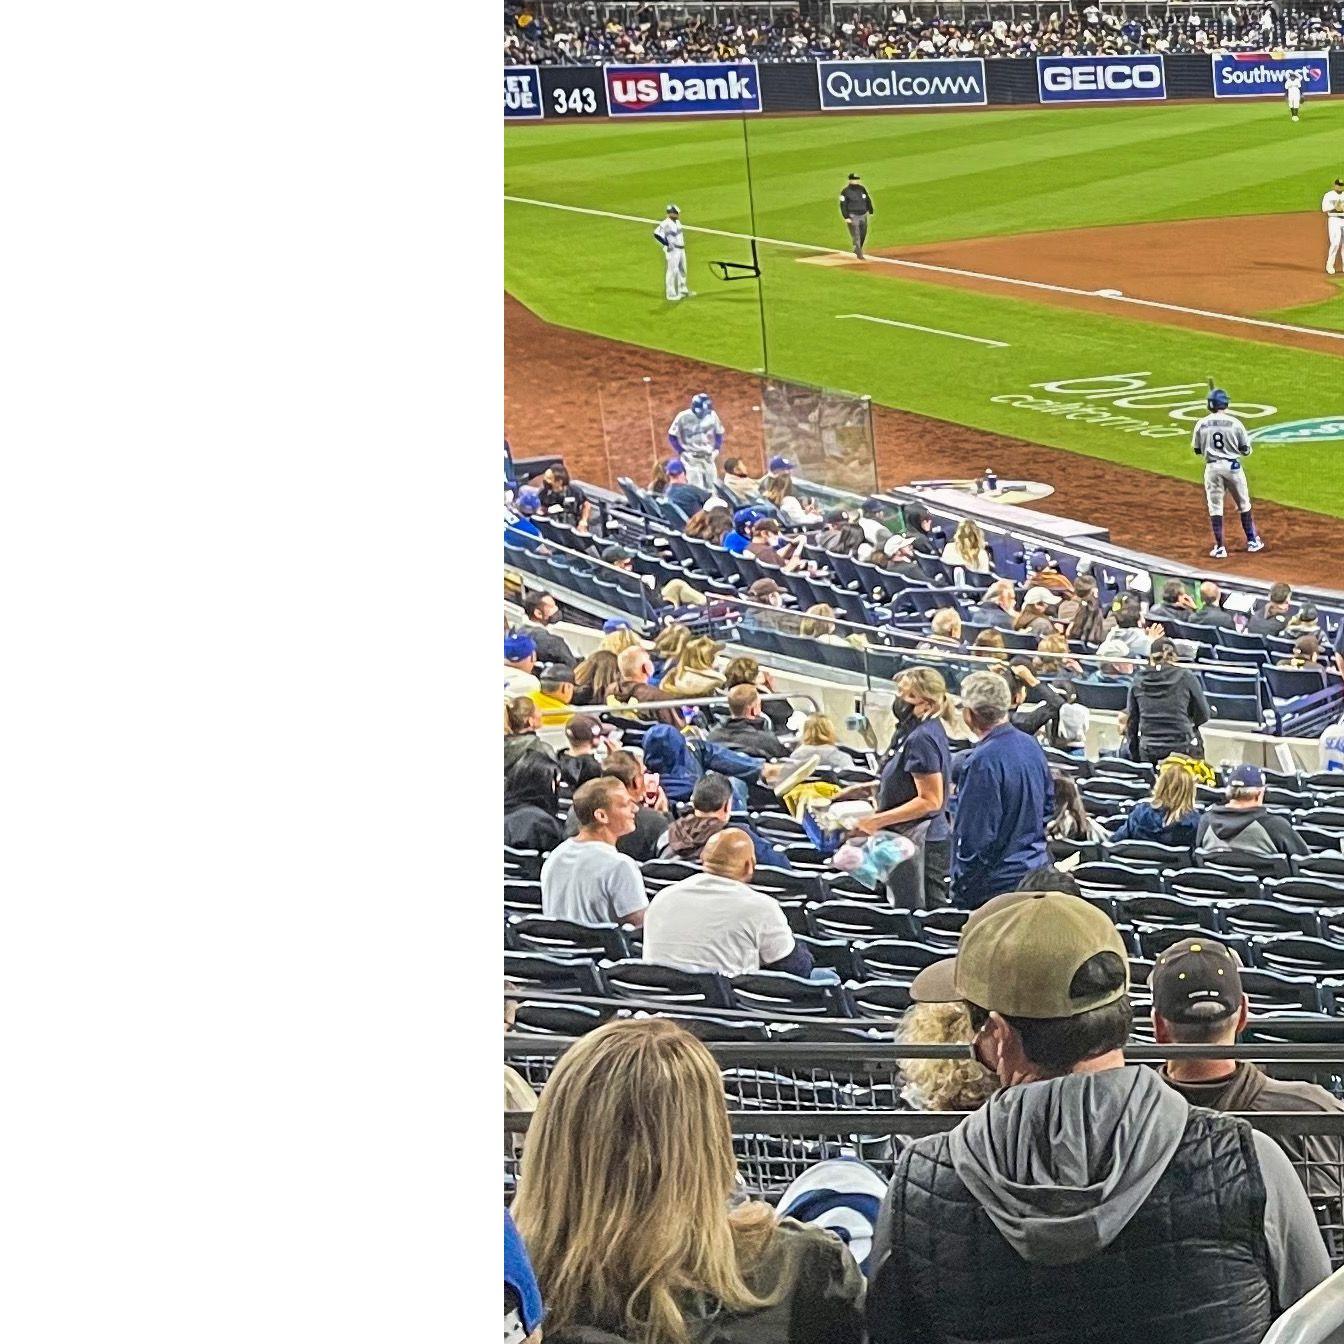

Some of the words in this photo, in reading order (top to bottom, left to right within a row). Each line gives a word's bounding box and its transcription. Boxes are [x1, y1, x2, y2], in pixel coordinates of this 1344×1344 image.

[504, 76, 530, 92] ET
[1044, 65, 1162, 91] GEICO
[1222, 64, 1310, 84] Southwest
[826, 70, 980, 101] Qualcomm
[504, 90, 536, 109] UE
[553, 87, 597, 114] 343
[1213, 432, 1224, 449] 8
